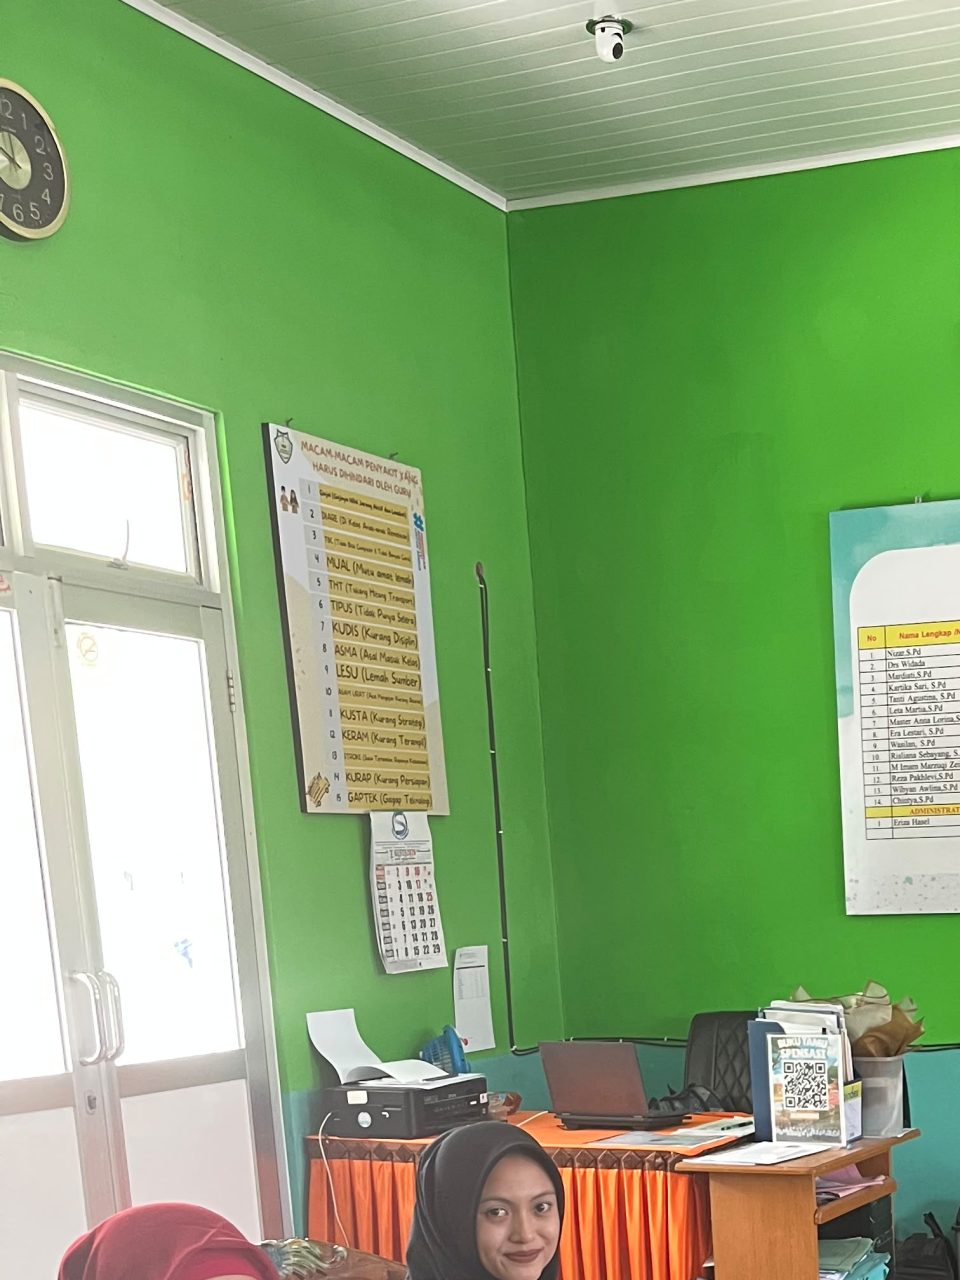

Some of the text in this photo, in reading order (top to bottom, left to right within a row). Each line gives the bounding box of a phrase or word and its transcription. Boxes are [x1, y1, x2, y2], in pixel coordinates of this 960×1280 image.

[22, 113, 27, 130] 1
[34, 136, 46, 155] 2
[43, 163, 54, 180] 3
[41, 188, 51, 205] 4
[12, 203, 24, 221] 6
[29, 202, 40, 220] 5
[312, 460, 411, 498] HARUS DIHINDARI OLEH GURU
[365, 459, 398, 479] PENYAKIT
[399, 469, 418, 486] YANG
[309, 509, 314, 519] 2
[311, 530, 317, 540] 3
[314, 553, 319, 563] 4
[325, 555, 350, 572] MUAL
[315, 578, 321, 587] 5
[328, 579, 343, 591] THT
[318, 599, 323, 609] 6
[330, 599, 352, 614] TIPUS
[319, 621, 325, 630] 7
[332, 621, 358, 637] KUDIS
[361, 626, 391, 645] (Kurang
[866, 634, 877, 642] No
[898, 631, 919, 639] Nama
[921, 629, 952, 639] Lengkap
[322, 643, 327, 652] 8
[334, 644, 357, 657] ASMA
[359, 647, 377, 661] (Asal
[324, 664, 421, 690] 9 LESU (Lemah Sumber)
[339, 708, 368, 721] KUSTA
[369, 711, 396, 727] (Kurang
[341, 729, 369, 741] KERAM
[370, 731, 397, 746] (Kurang
[345, 772, 371, 782] KURAP
[373, 773, 398, 786] (Kurang
[347, 792, 377, 803] GAPTEK
[409, 907, 415, 916] 12
[430, 918, 435, 928] 27
[422, 932, 427, 941] 21
[414, 944, 440, 955] 15 22 29
